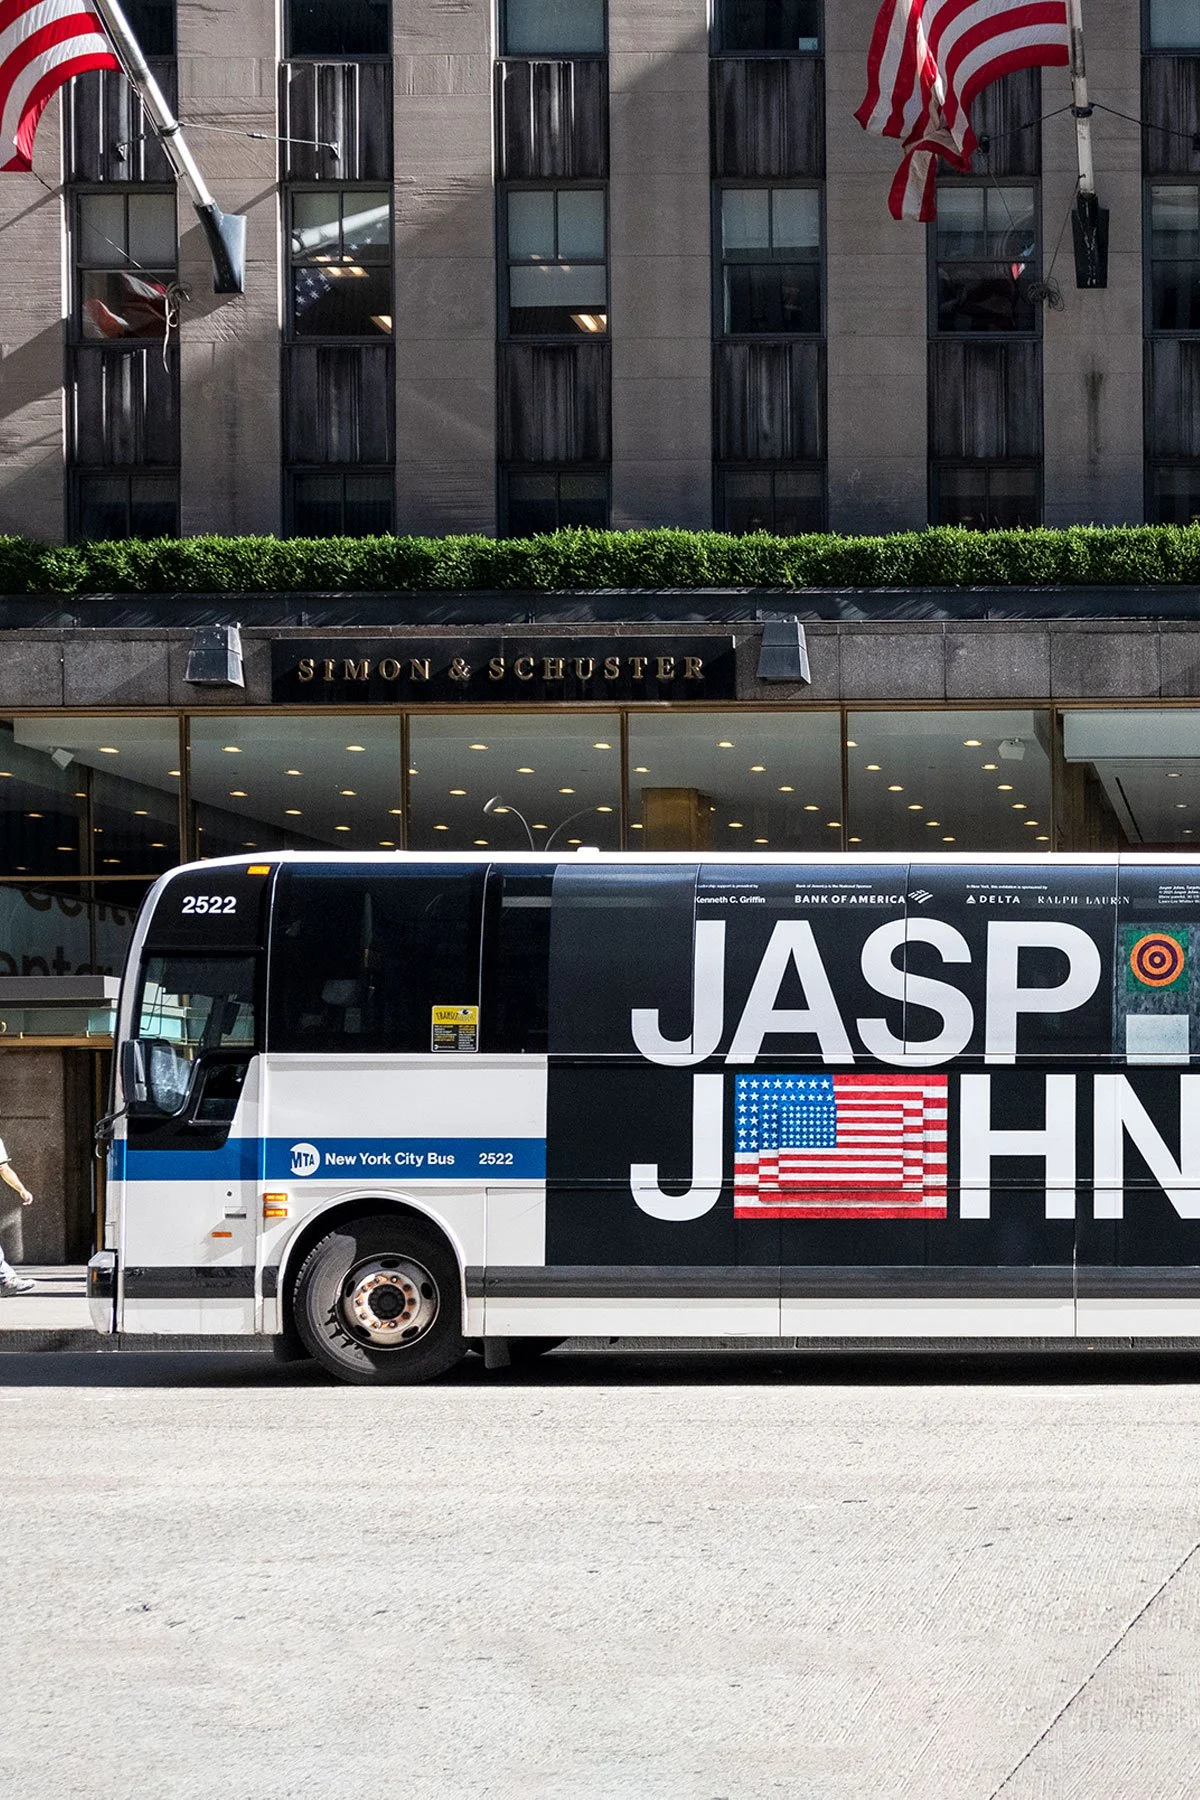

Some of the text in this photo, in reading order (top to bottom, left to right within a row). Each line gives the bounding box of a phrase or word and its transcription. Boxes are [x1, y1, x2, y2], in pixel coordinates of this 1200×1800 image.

[298, 656, 705, 681] SIMON & SCHUSTER
[181, 896, 237, 914] 2522
[695, 896, 766, 904] Kenneth C. Griffin
[794, 895, 906, 904] BANK OF AMERICA
[979, 895, 1020, 904] DELTA
[1038, 896, 1078, 904] RALPH
[325, 1152, 455, 1168] New York City Bus
[478, 1152, 514, 1166] 2522
